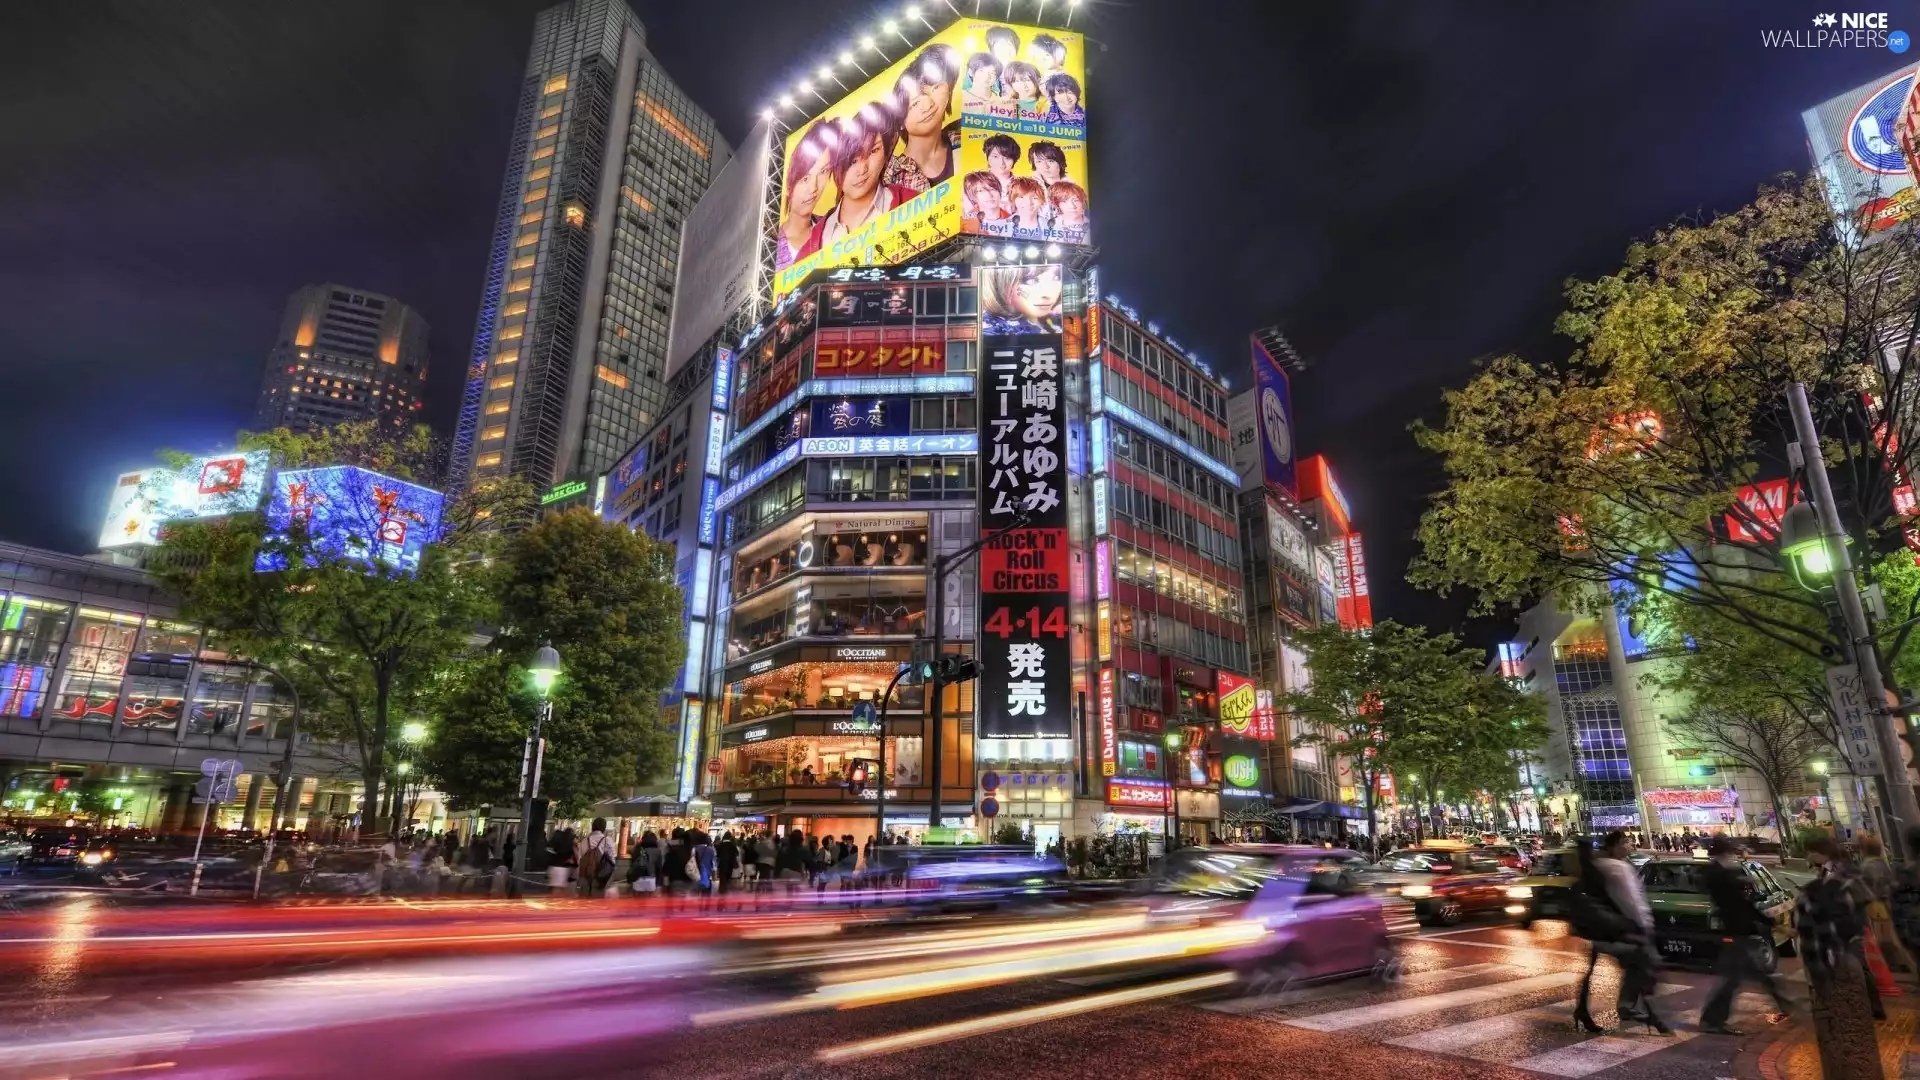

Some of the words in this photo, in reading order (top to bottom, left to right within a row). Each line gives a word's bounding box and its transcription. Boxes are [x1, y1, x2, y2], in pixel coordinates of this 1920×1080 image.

[990, 105, 1018, 117] Hey!
[1021, 109, 1046, 121] Say!
[964, 116, 992, 127] Hey!
[996, 120, 1022, 131] Say!
[1049, 127, 1083, 137] JUMP
[781, 251, 825, 288] Hey!
[832, 221, 877, 260] Say!
[884, 182, 951, 231] JUMP
[980, 222, 1008, 233] Hey!
[817, 345, 943, 368] コンタクト
[988, 351, 1019, 515] ニューアルバム
[1021, 347, 1060, 513] 浜崎あゆみ
[807, 440, 850, 451] AEON
[858, 437, 973, 452] 英会話イーオン
[542, 489, 566, 502] MARK
[566, 482, 588, 494] CITY
[1744, 485, 1784, 514] H&M
[847, 520, 881, 529] Natural
[885, 518, 916, 528] Dining
[988, 530, 1061, 549] Rock'n'
[1006, 550, 1045, 569] Roll
[993, 570, 1058, 590] Circus
[837, 648, 887, 657] L'OCCITANE
[1007, 643, 1046, 716] 発売
[1833, 675, 1870, 758] 文化村通り
[1228, 758, 1255, 781] LUSH
